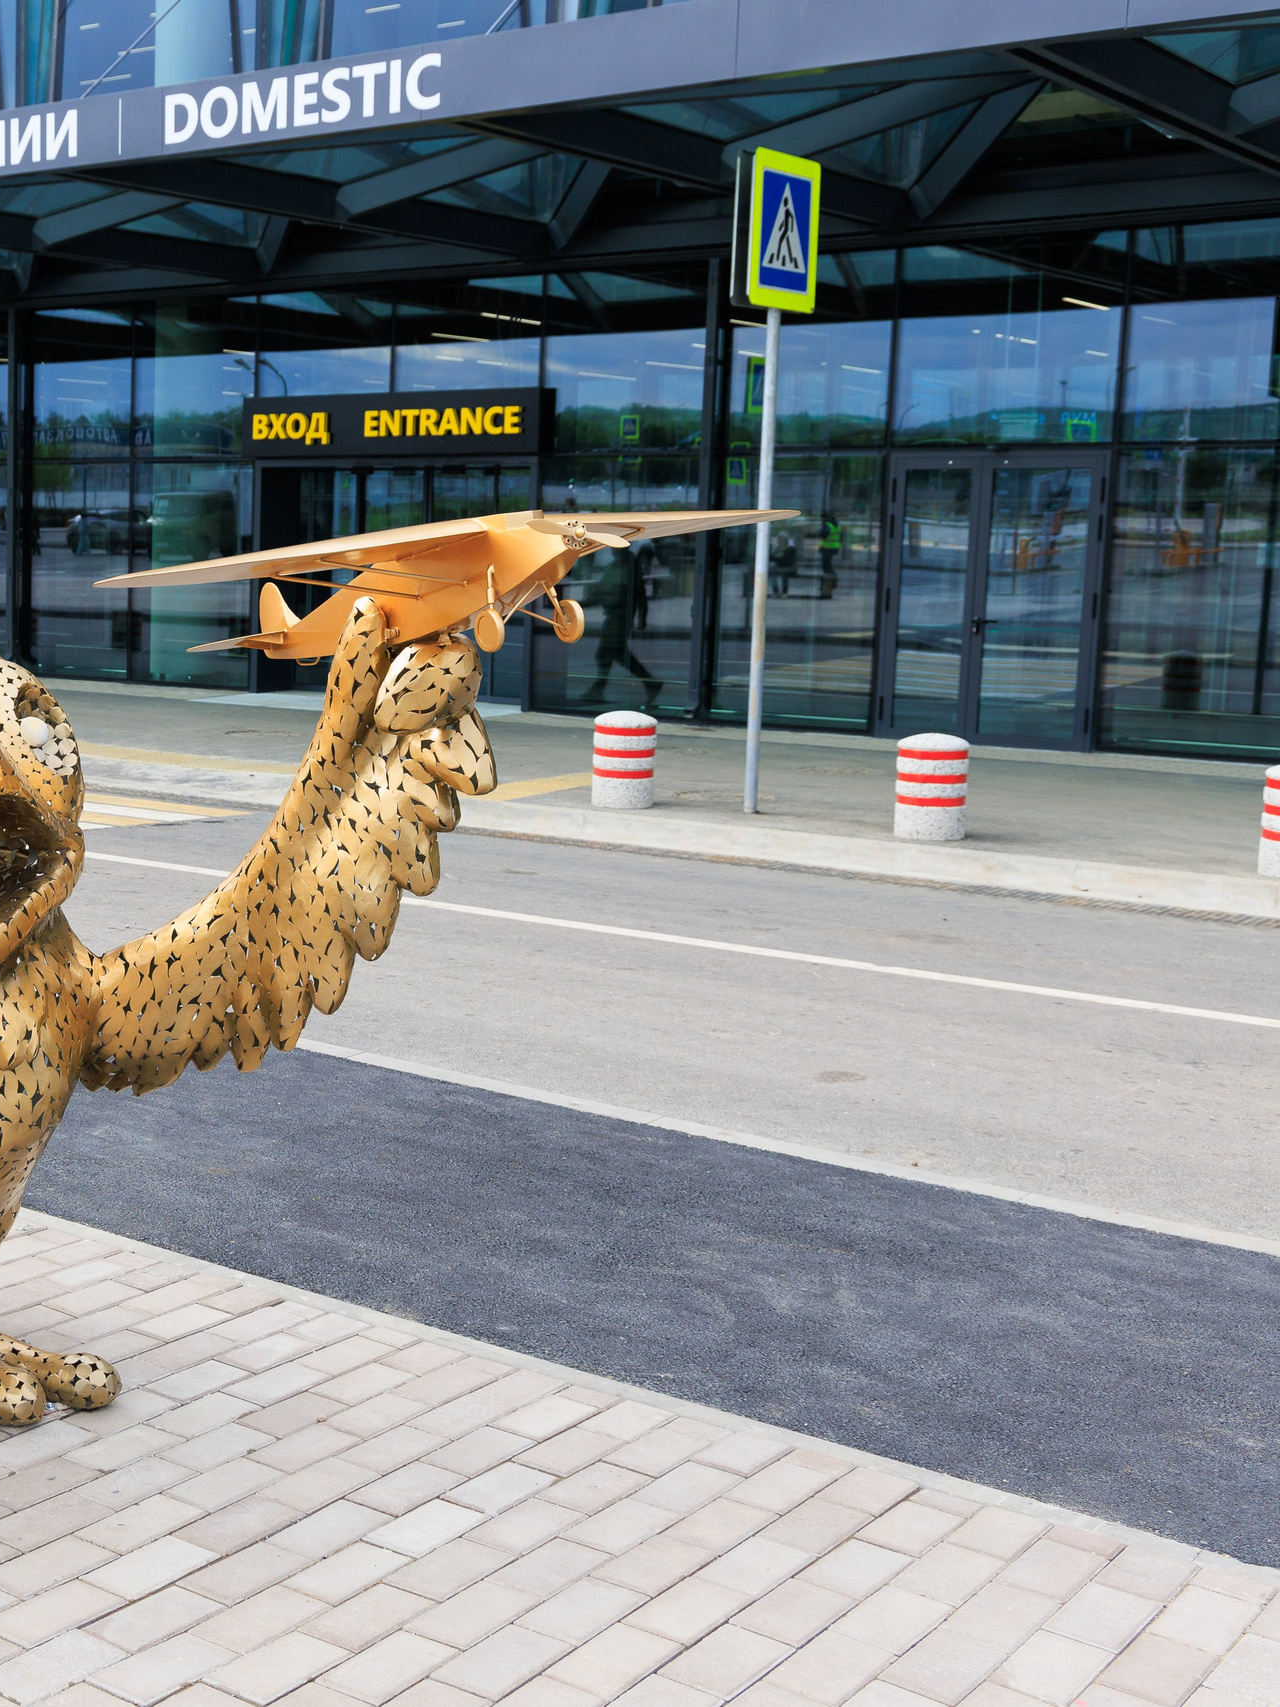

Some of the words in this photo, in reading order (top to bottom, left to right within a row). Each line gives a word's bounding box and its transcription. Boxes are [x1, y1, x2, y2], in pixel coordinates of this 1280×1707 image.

[164, 52, 442, 145] DOMESTIC
[252, 412, 329, 445] ВХОД
[363, 405, 521, 438] ENTRANCE
